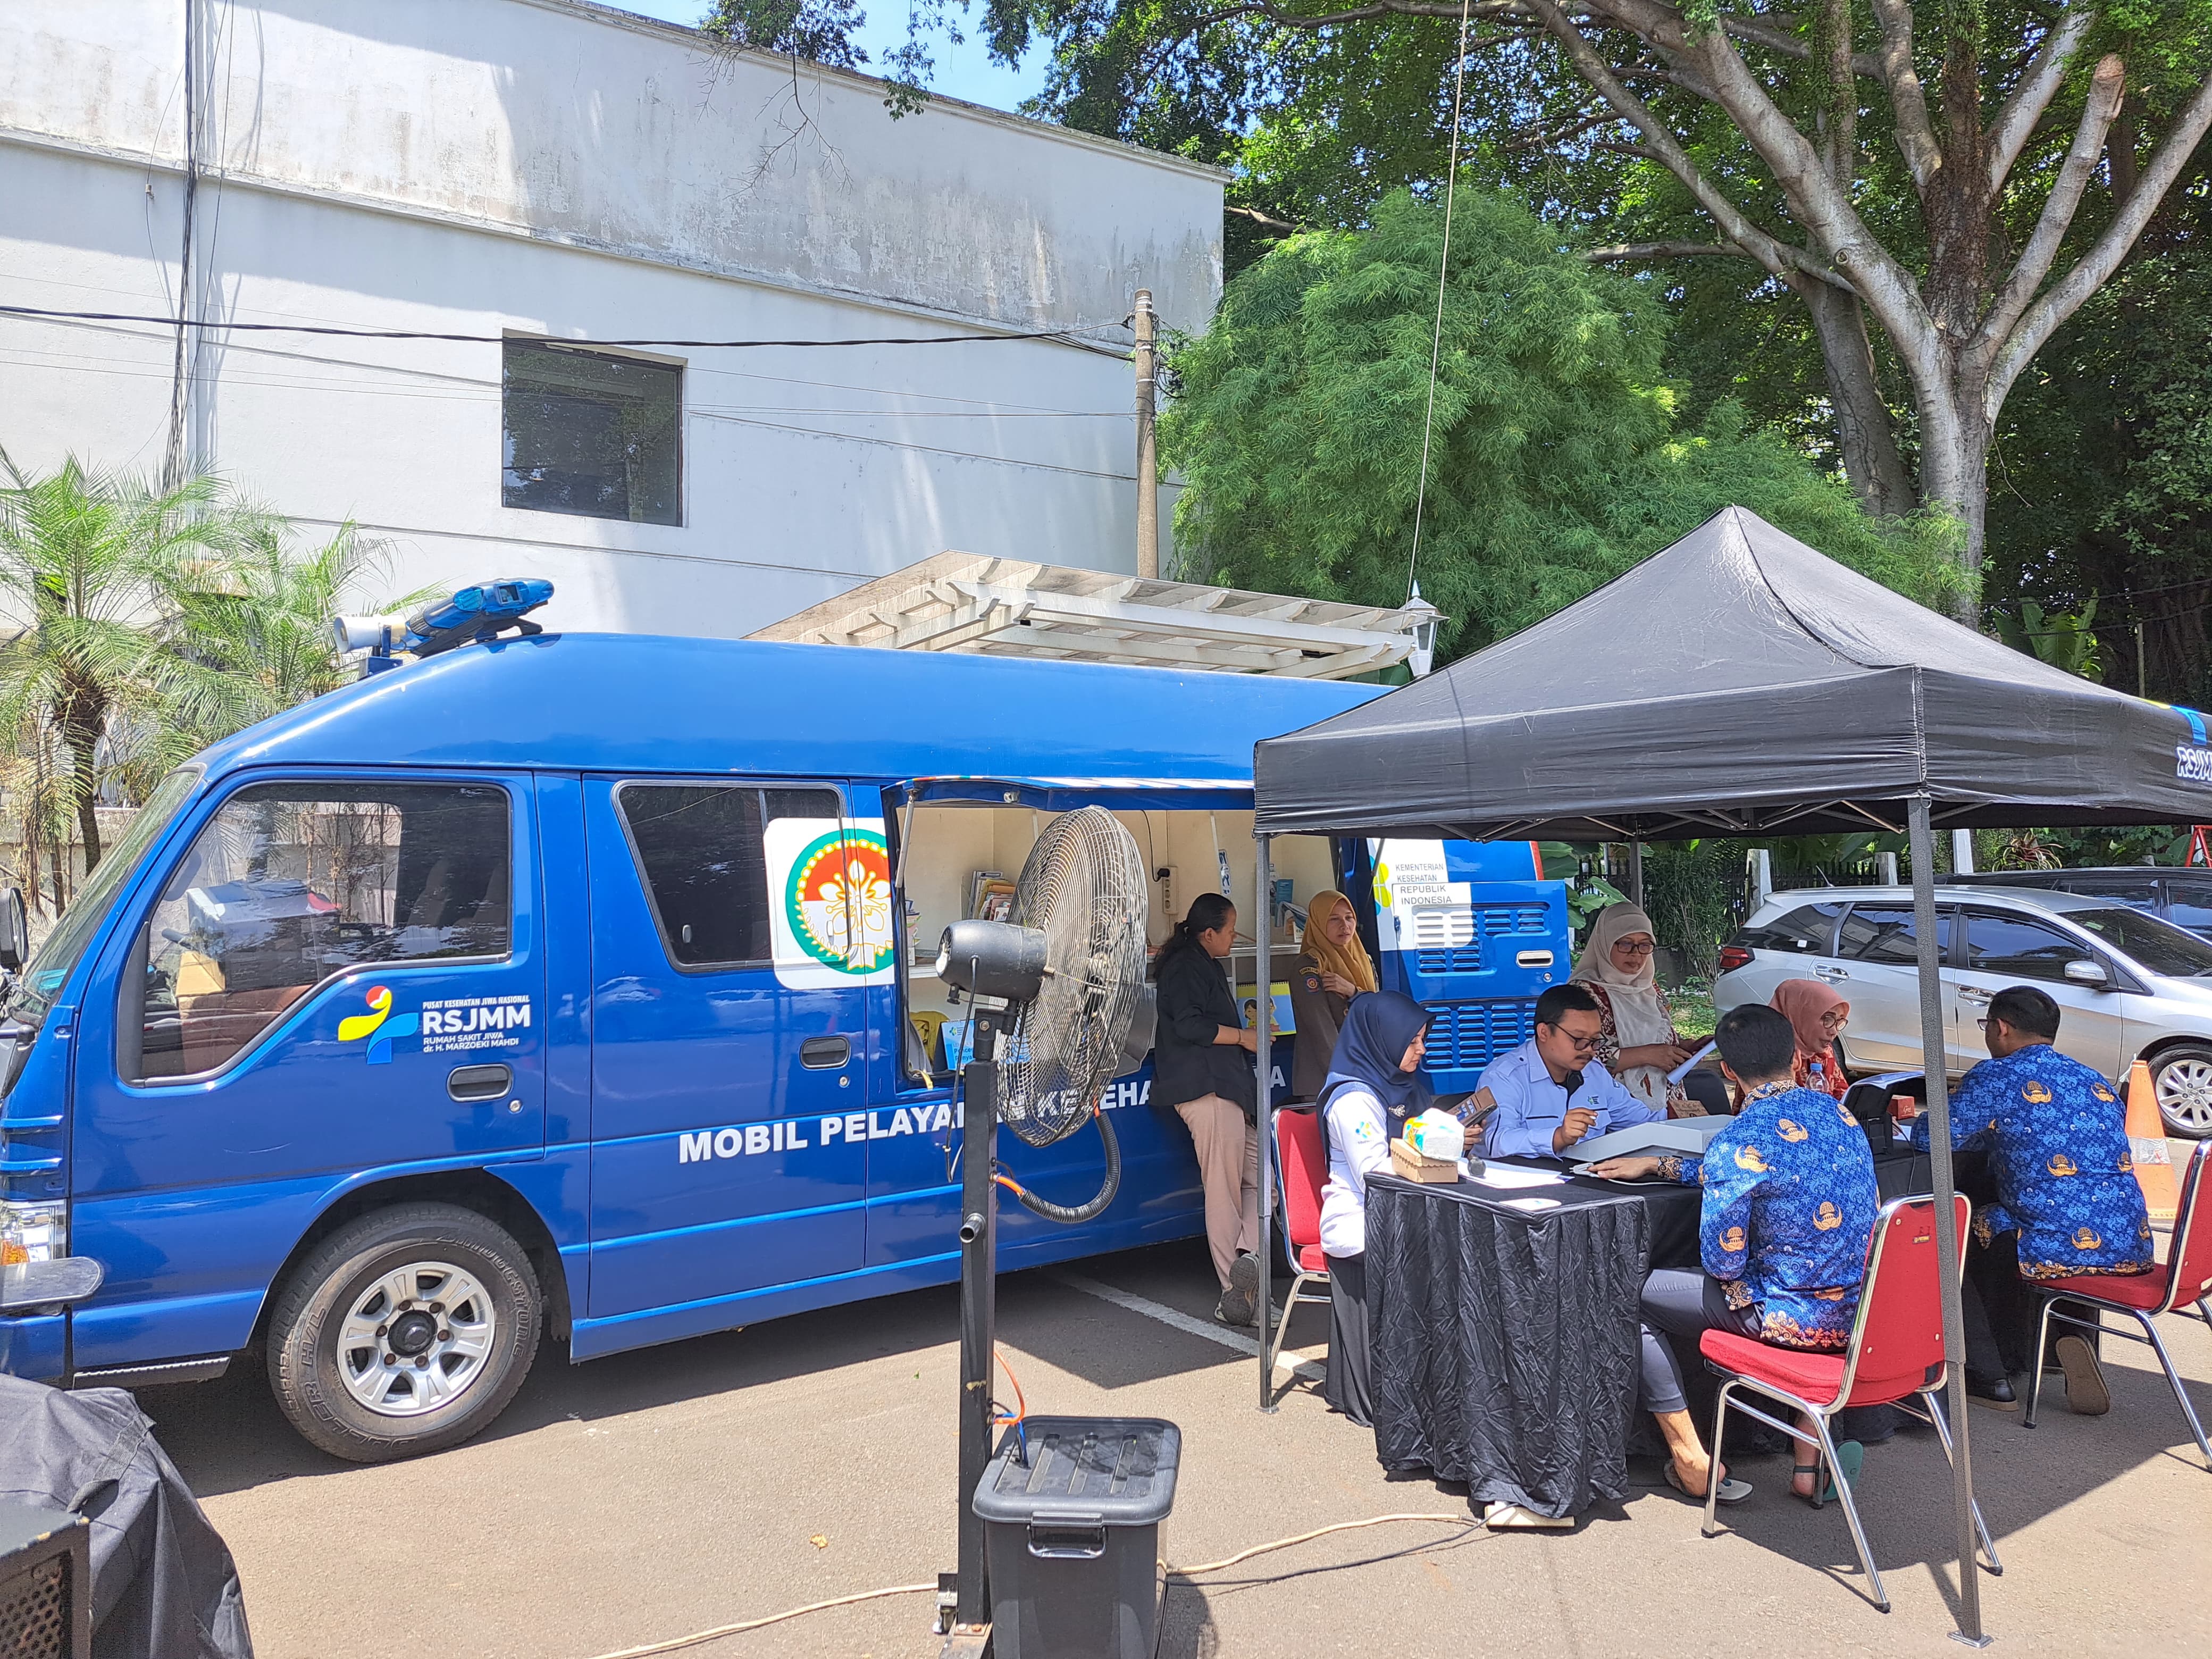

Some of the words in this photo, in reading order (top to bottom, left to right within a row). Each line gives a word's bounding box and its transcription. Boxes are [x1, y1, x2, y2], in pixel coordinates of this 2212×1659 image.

[1395, 863, 1444, 872] KEMENTERIAN
[1400, 885, 1446, 894] REPUBLIK
[1401, 896, 1452, 905] INDONESIA
[423, 1000, 443, 1009] PUSAT
[445, 998, 480, 1008] KESEHATAN
[481, 997, 497, 1006] JIWA
[498, 995, 530, 1004] NASIONAL
[423, 1004, 531, 1035] RSJMM
[423, 1037, 456, 1045] RUMAH
[457, 1033, 482, 1042] SAKIT
[483, 1032, 503, 1040] JIWA
[446, 1041, 489, 1051] MARZOEKI
[491, 1037, 519, 1048] MAHDI
[679, 1121, 808, 1163] MOBIL
